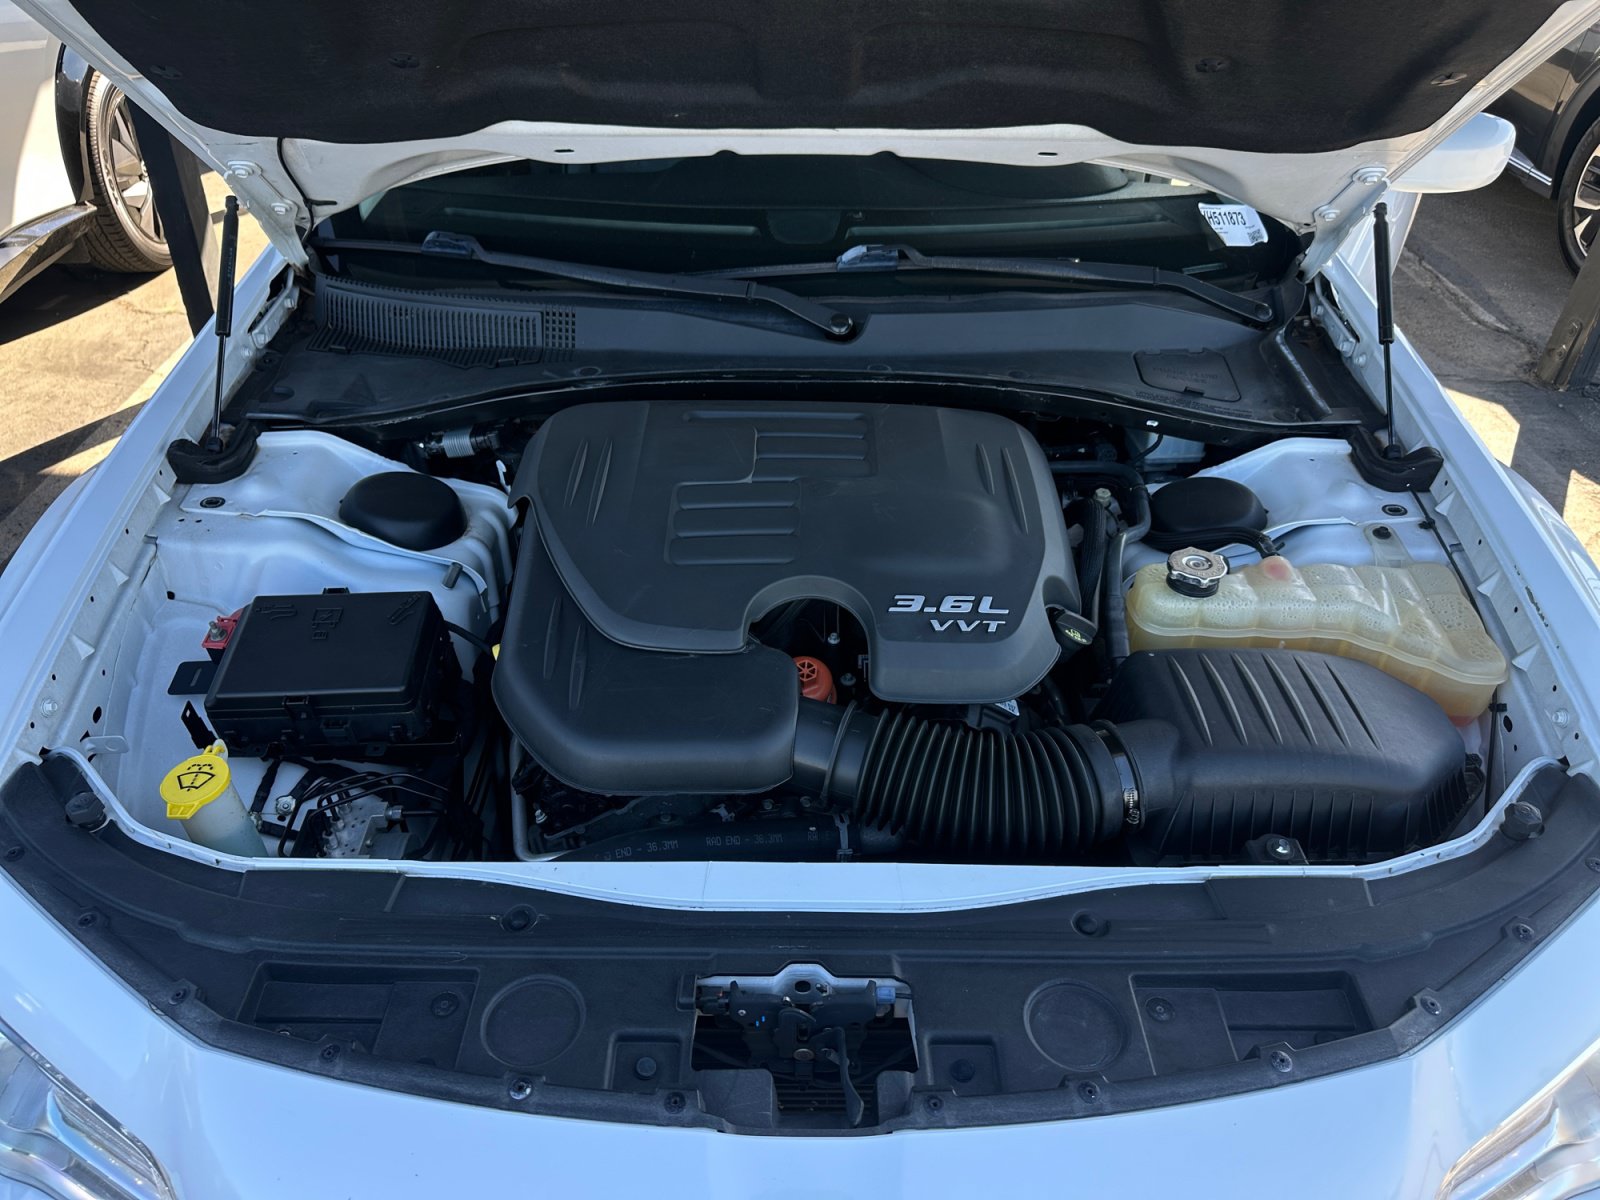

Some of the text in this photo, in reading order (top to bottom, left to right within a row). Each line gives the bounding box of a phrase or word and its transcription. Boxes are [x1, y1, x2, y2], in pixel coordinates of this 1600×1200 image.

[887, 594, 1010, 615] 3.6L
[929, 619, 1006, 633] VVT
[706, 836, 722, 847] RAD
[725, 836, 741, 846] END
[615, 846, 632, 859] END
